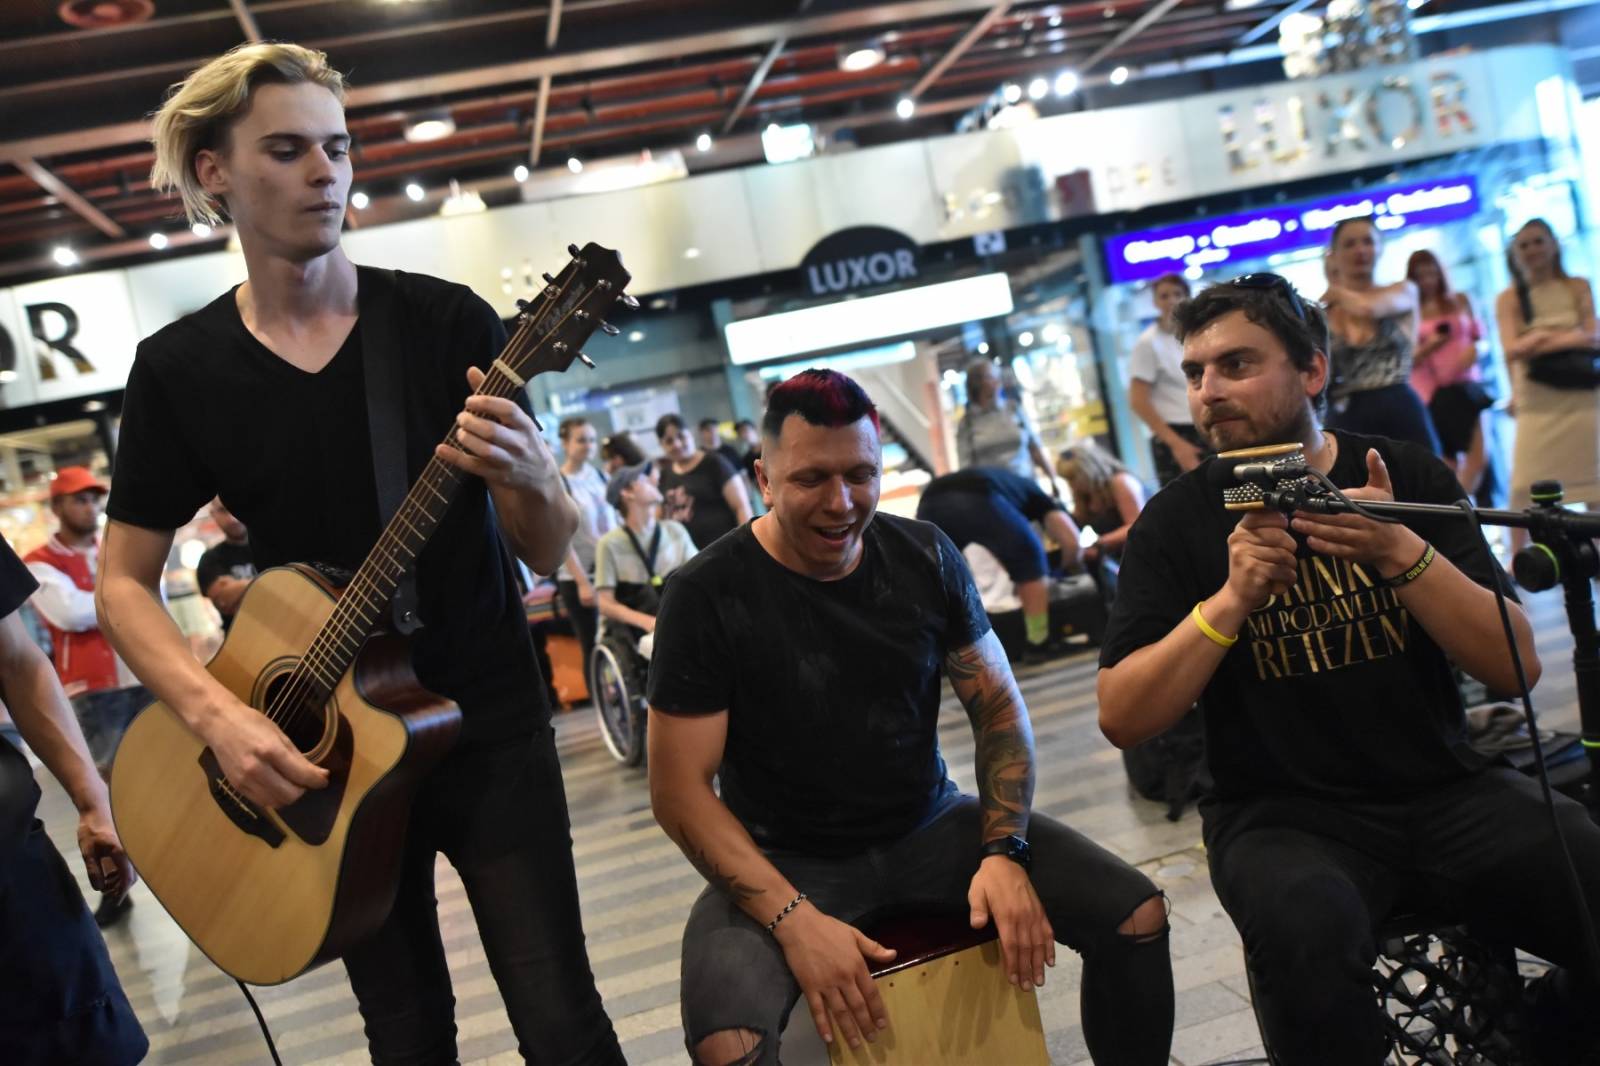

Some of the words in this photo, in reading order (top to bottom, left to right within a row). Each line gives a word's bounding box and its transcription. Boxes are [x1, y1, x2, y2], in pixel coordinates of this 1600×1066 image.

[1216, 71, 1478, 174] LUXOR
[808, 248, 917, 295] LUXOR
[0, 302, 97, 385] R
[1251, 555, 1375, 613] INK
